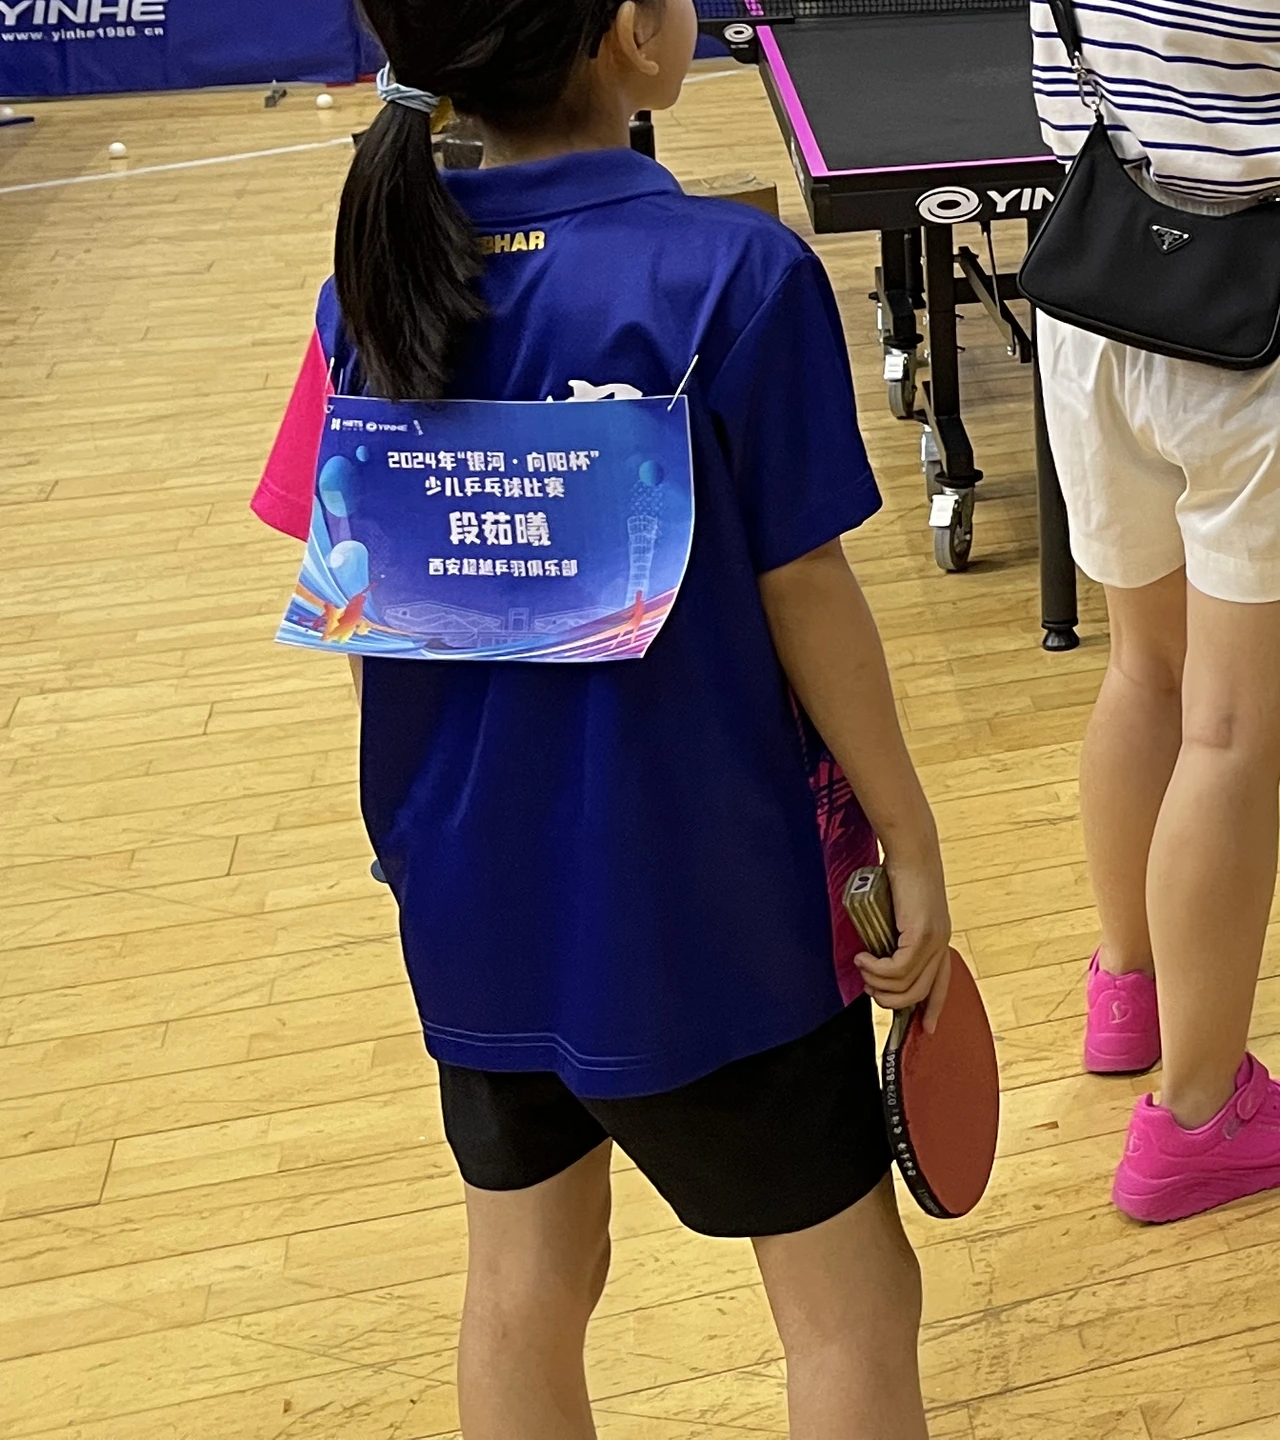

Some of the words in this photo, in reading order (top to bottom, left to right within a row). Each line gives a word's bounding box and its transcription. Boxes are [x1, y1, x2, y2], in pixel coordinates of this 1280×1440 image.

[986, 187, 1055, 213] YIN
[424, 476, 565, 498] 少儿乒乓球比赛
[428, 558, 578, 576] 西安超越乒羽俱乐部
